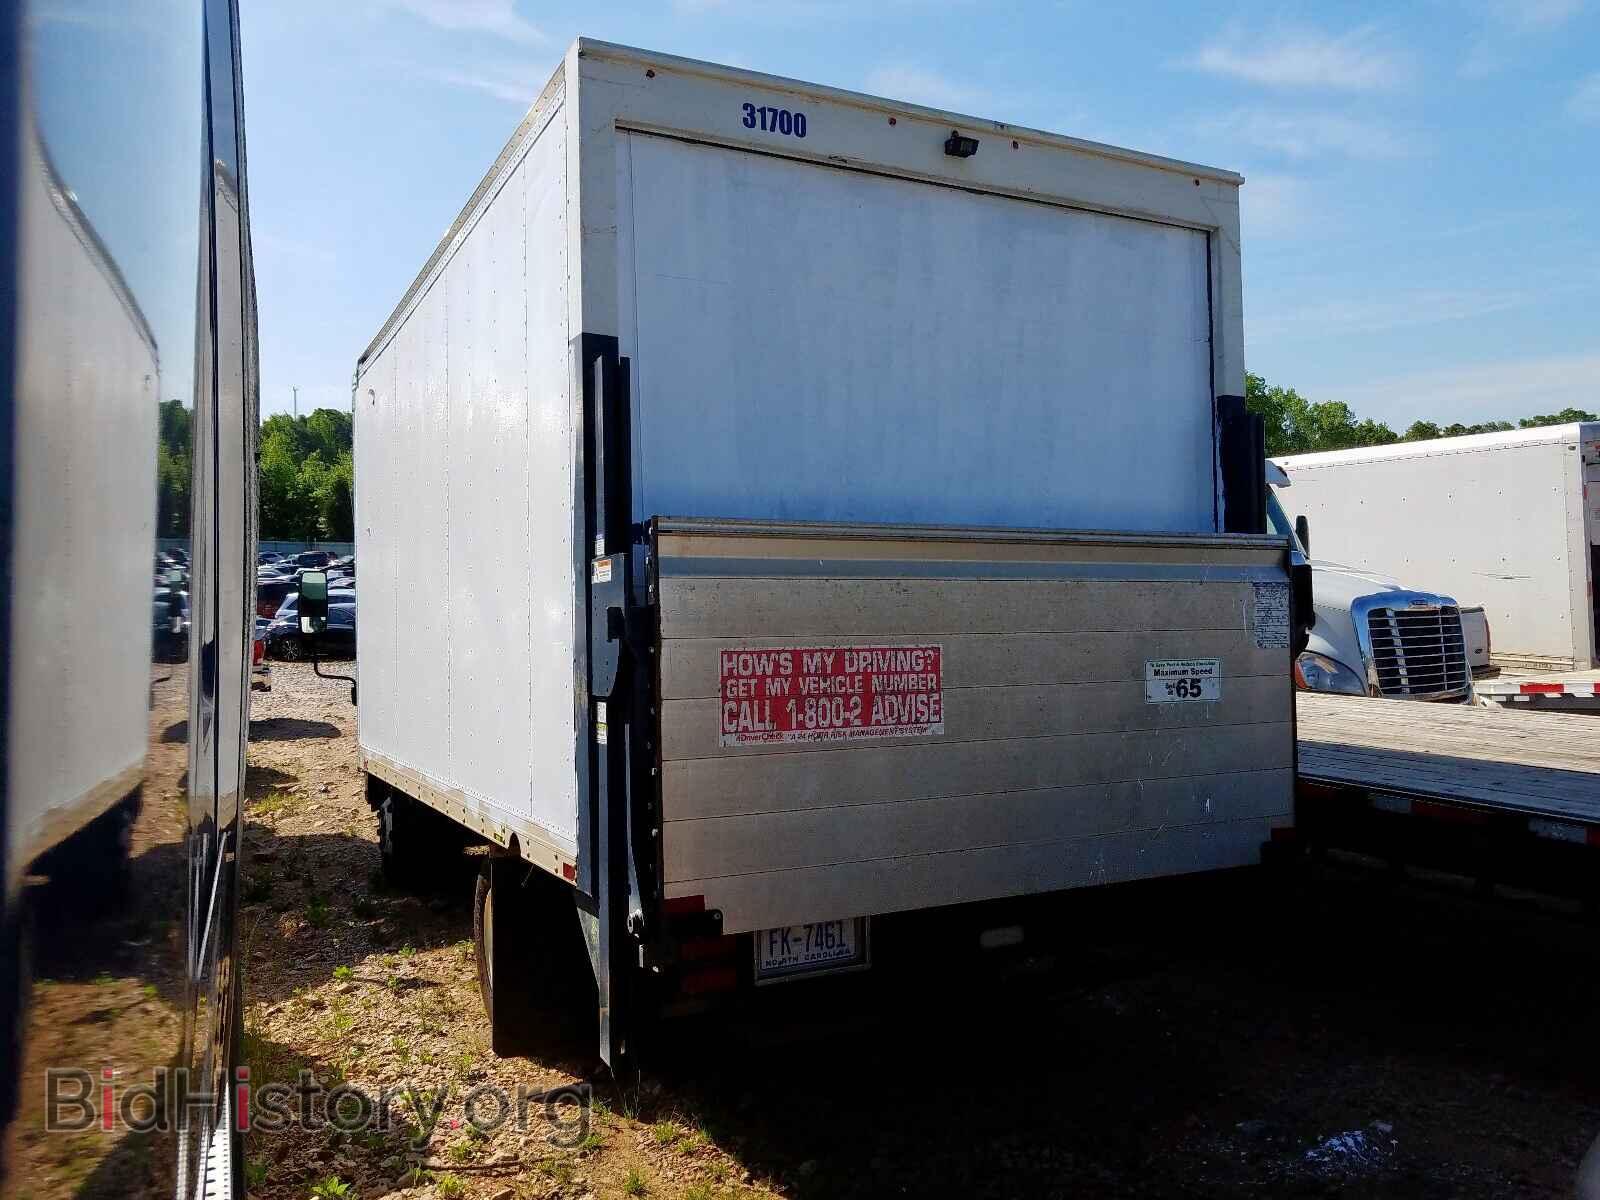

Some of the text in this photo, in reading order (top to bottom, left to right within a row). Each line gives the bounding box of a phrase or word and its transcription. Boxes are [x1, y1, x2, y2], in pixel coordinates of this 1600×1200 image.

[743, 102, 807, 138] 31700
[722, 650, 934, 677] HOW'S MY DRIVING?
[1153, 667, 1213, 677] Maximum Speed
[726, 674, 936, 698] GET MY VEHICLE NUMBER
[1176, 678, 1201, 699] 65
[722, 693, 942, 733] CALL 1-800-2 ADVISE
[769, 921, 846, 957] FK-7461
[765, 948, 851, 968] NORTH CAROLINA
